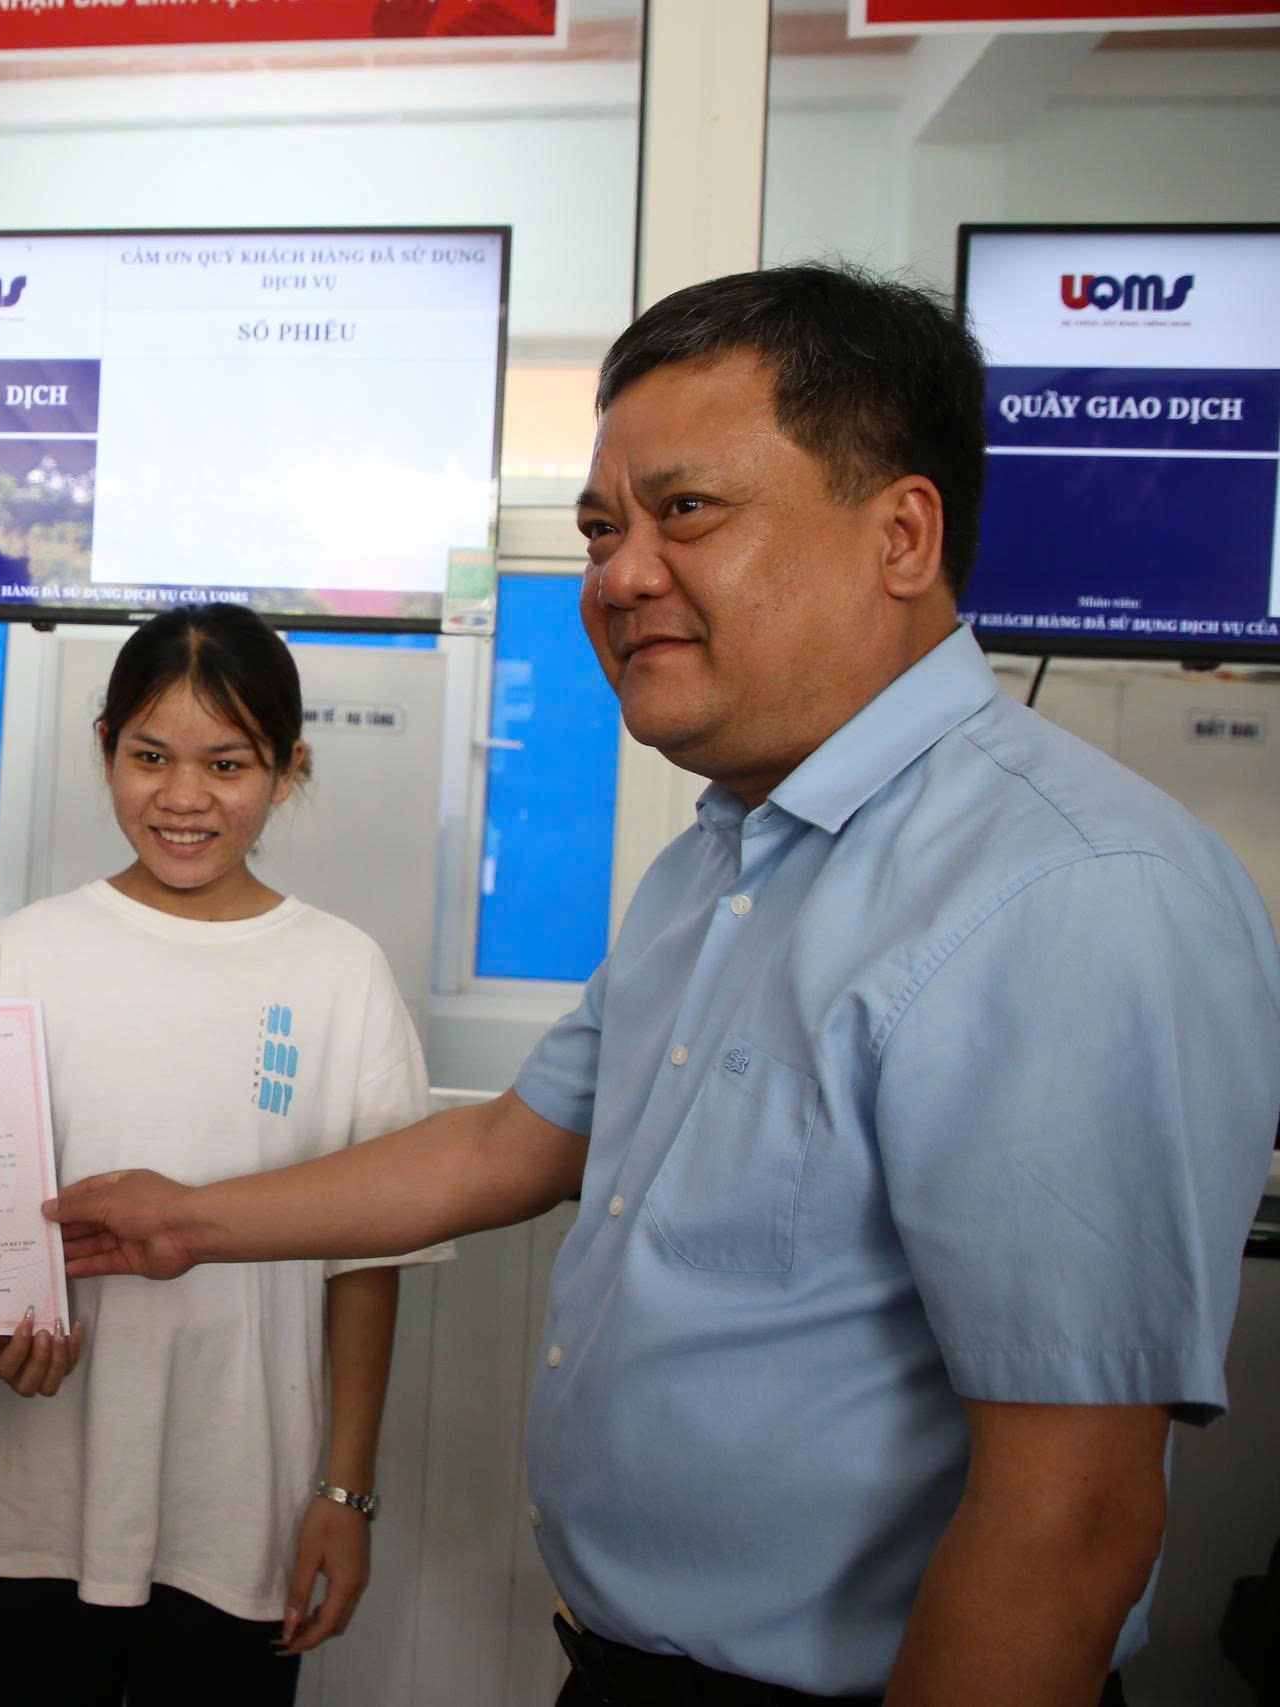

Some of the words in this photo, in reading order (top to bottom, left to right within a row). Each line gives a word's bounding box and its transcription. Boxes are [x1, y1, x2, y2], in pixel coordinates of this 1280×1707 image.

[121, 245, 160, 265] CẢM
[197, 245, 234, 268] QUÝ
[241, 245, 306, 265] KHÁCH
[310, 245, 365, 264] HÀNG
[431, 248, 486, 266] DỤNG
[237, 318, 271, 342] SỐ
[279, 318, 357, 342] PHIẾU
[5, 384, 69, 410] DỊCH
[999, 389, 1081, 424] QUẦY
[1085, 395, 1162, 420] GIAO
[1167, 397, 1244, 424] DỊCH
